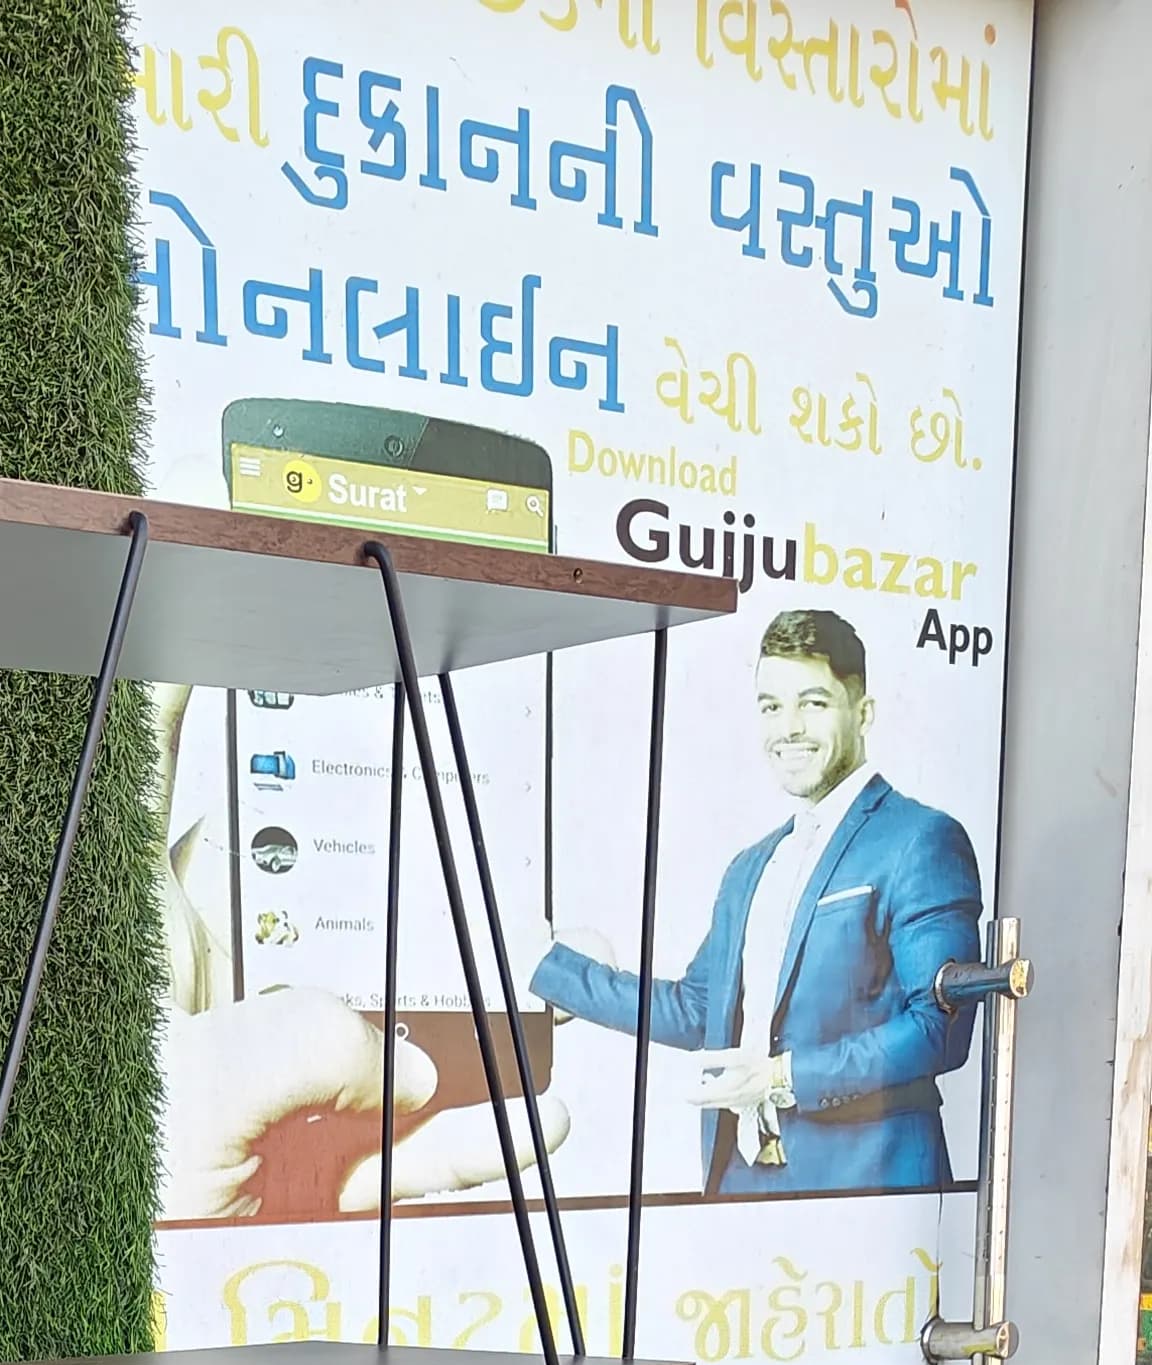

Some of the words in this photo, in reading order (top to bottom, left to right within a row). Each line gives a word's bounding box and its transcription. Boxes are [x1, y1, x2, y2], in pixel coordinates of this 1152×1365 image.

[280, 56, 660, 238] દુકાનની
[710, 161, 995, 319] વસ્તુઓ
[655, 336, 762, 436] વેચી
[789, 372, 883, 456] શકો
[909, 388, 983, 472] છો.
[327, 473, 408, 513] Surat
[567, 428, 737, 497] Download
[615, 498, 978, 601] Gujjubazar
[915, 607, 994, 668] App
[311, 759, 391, 780] Electronics
[312, 838, 376, 855] Vehicles
[314, 915, 375, 933] Animals
